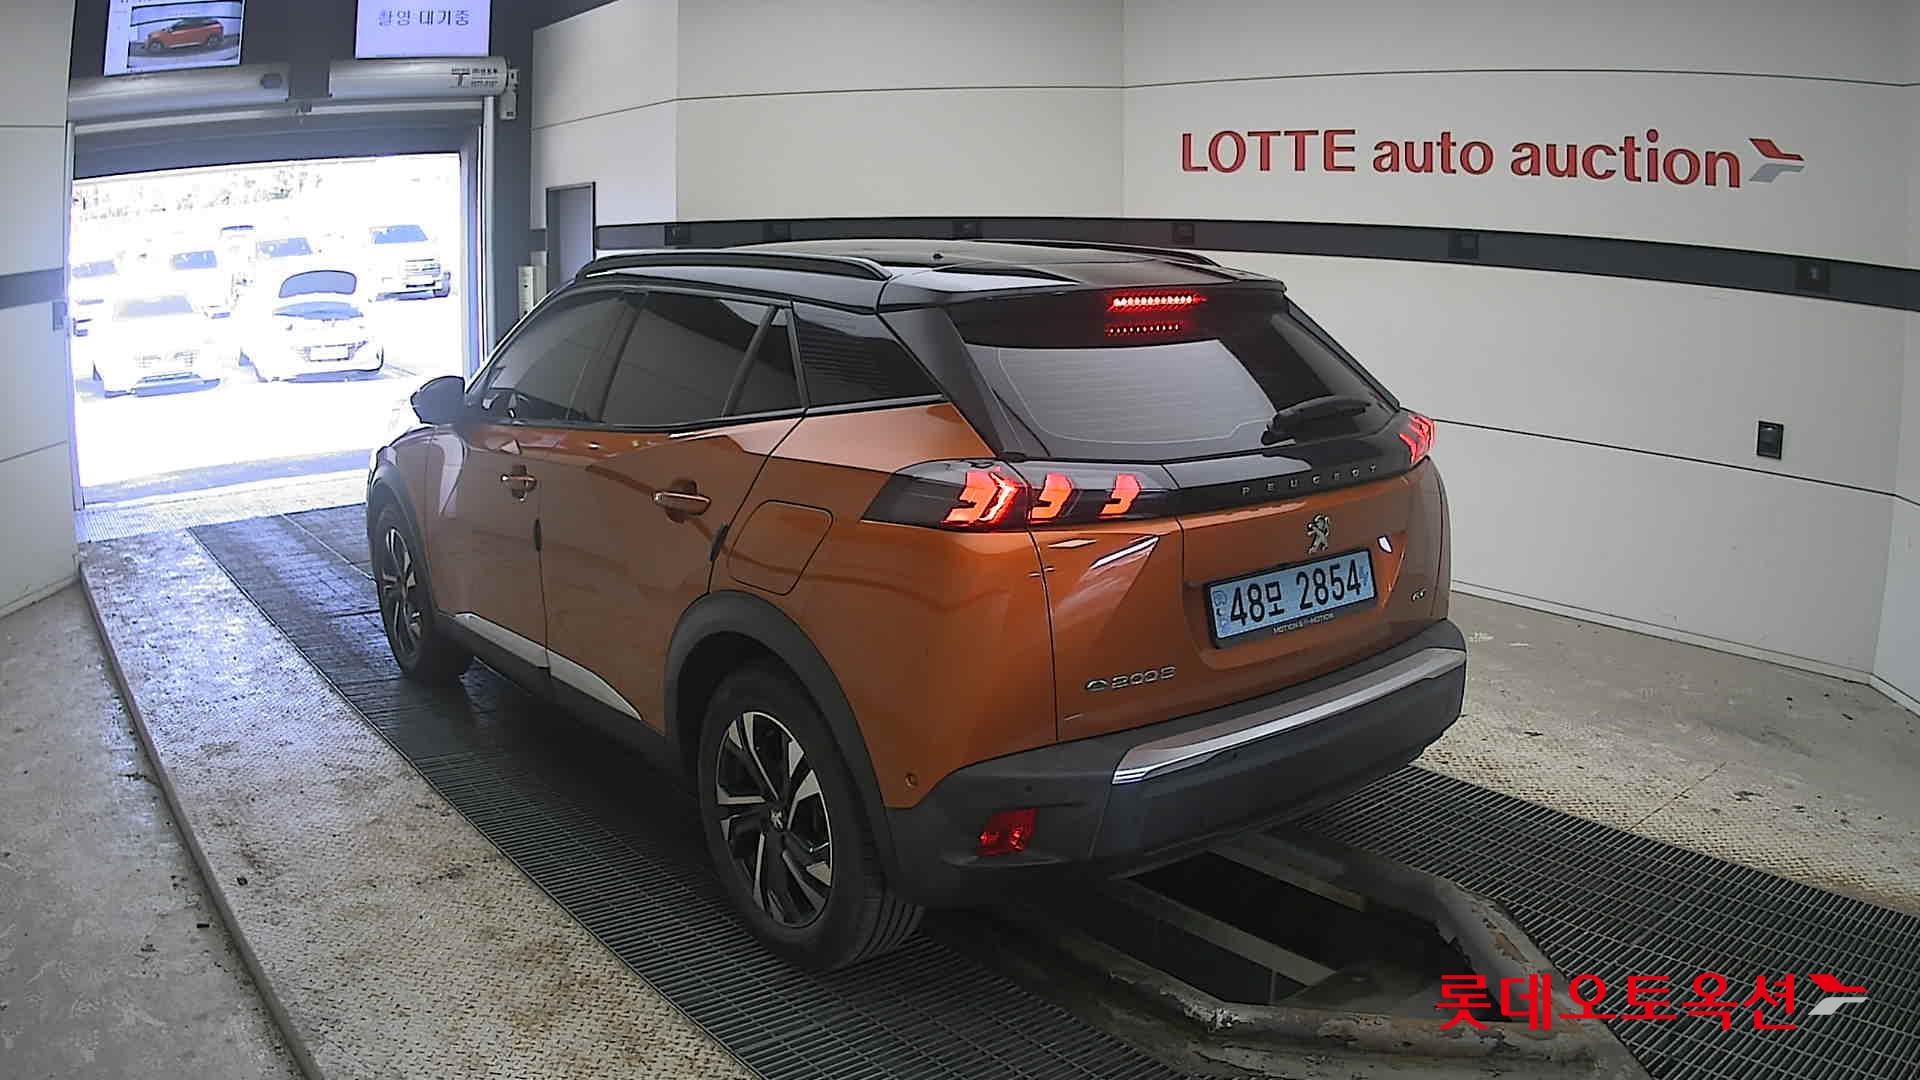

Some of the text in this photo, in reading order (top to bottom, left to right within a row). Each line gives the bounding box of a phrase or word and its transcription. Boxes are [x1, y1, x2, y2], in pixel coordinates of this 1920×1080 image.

[418, 9, 470, 26] 대기중
[1181, 128, 1742, 188] LOTTE auto auction
[1230, 558, 1362, 626] 48모 2854
